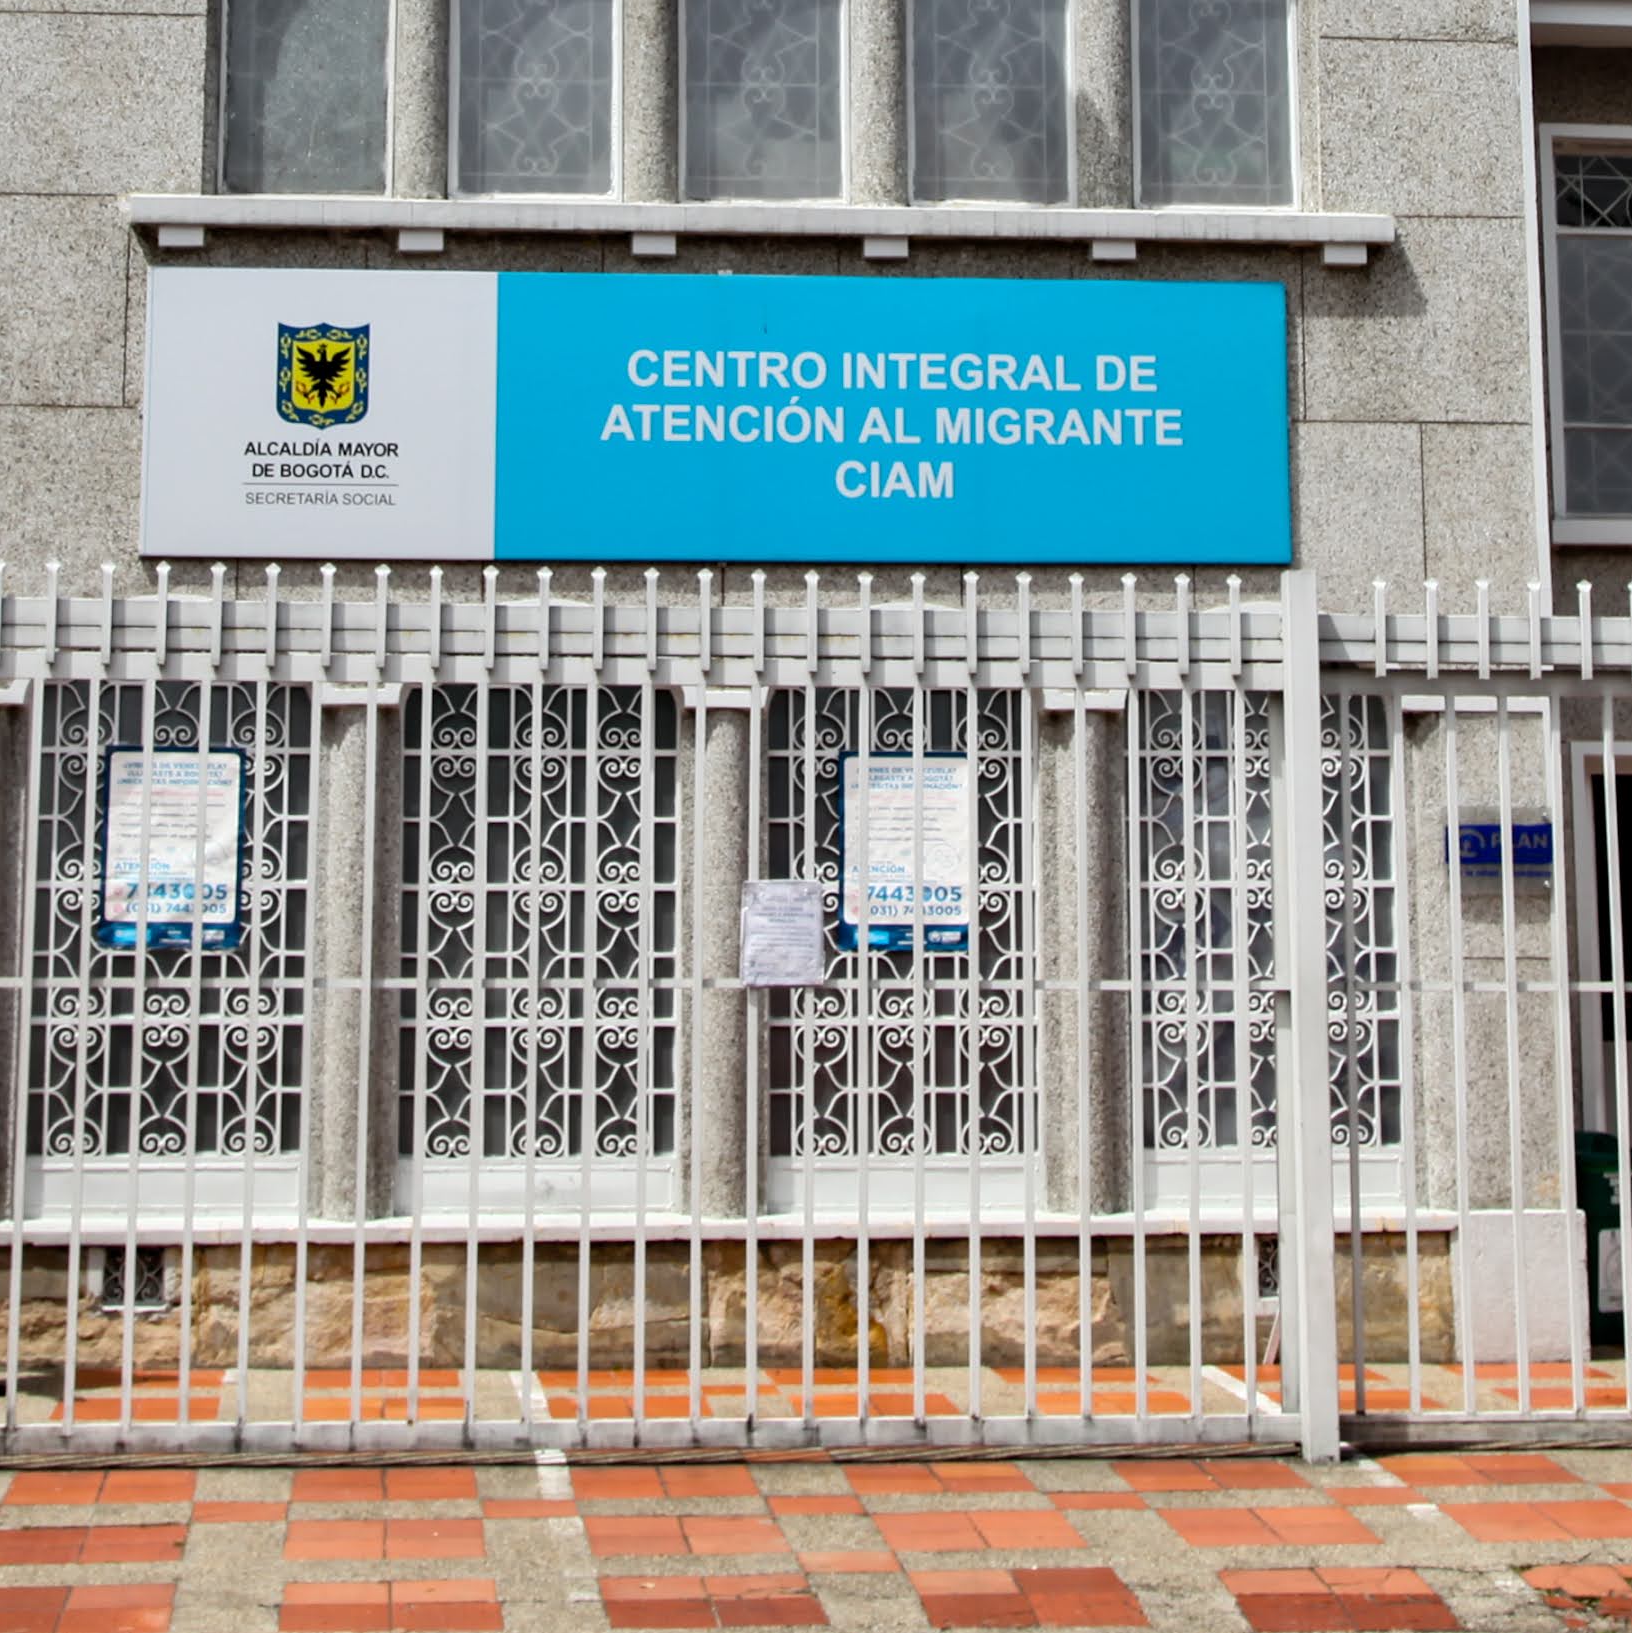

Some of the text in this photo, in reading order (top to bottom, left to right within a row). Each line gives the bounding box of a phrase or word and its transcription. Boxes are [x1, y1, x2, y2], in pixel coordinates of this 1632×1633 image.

[627, 349, 1158, 392] CENTRO INTEGRAL DE
[600, 395, 1183, 446] ATENCIÓN AL MIGRANTE
[243, 438, 399, 458] ALCALDÍA MAYOR
[251, 460, 390, 479] DE BOGOTÁ D.C.
[835, 460, 954, 498] CIAM
[245, 489, 397, 507] SECRETARÍA SOCIAL
[851, 863, 905, 874] AENCIÓN
